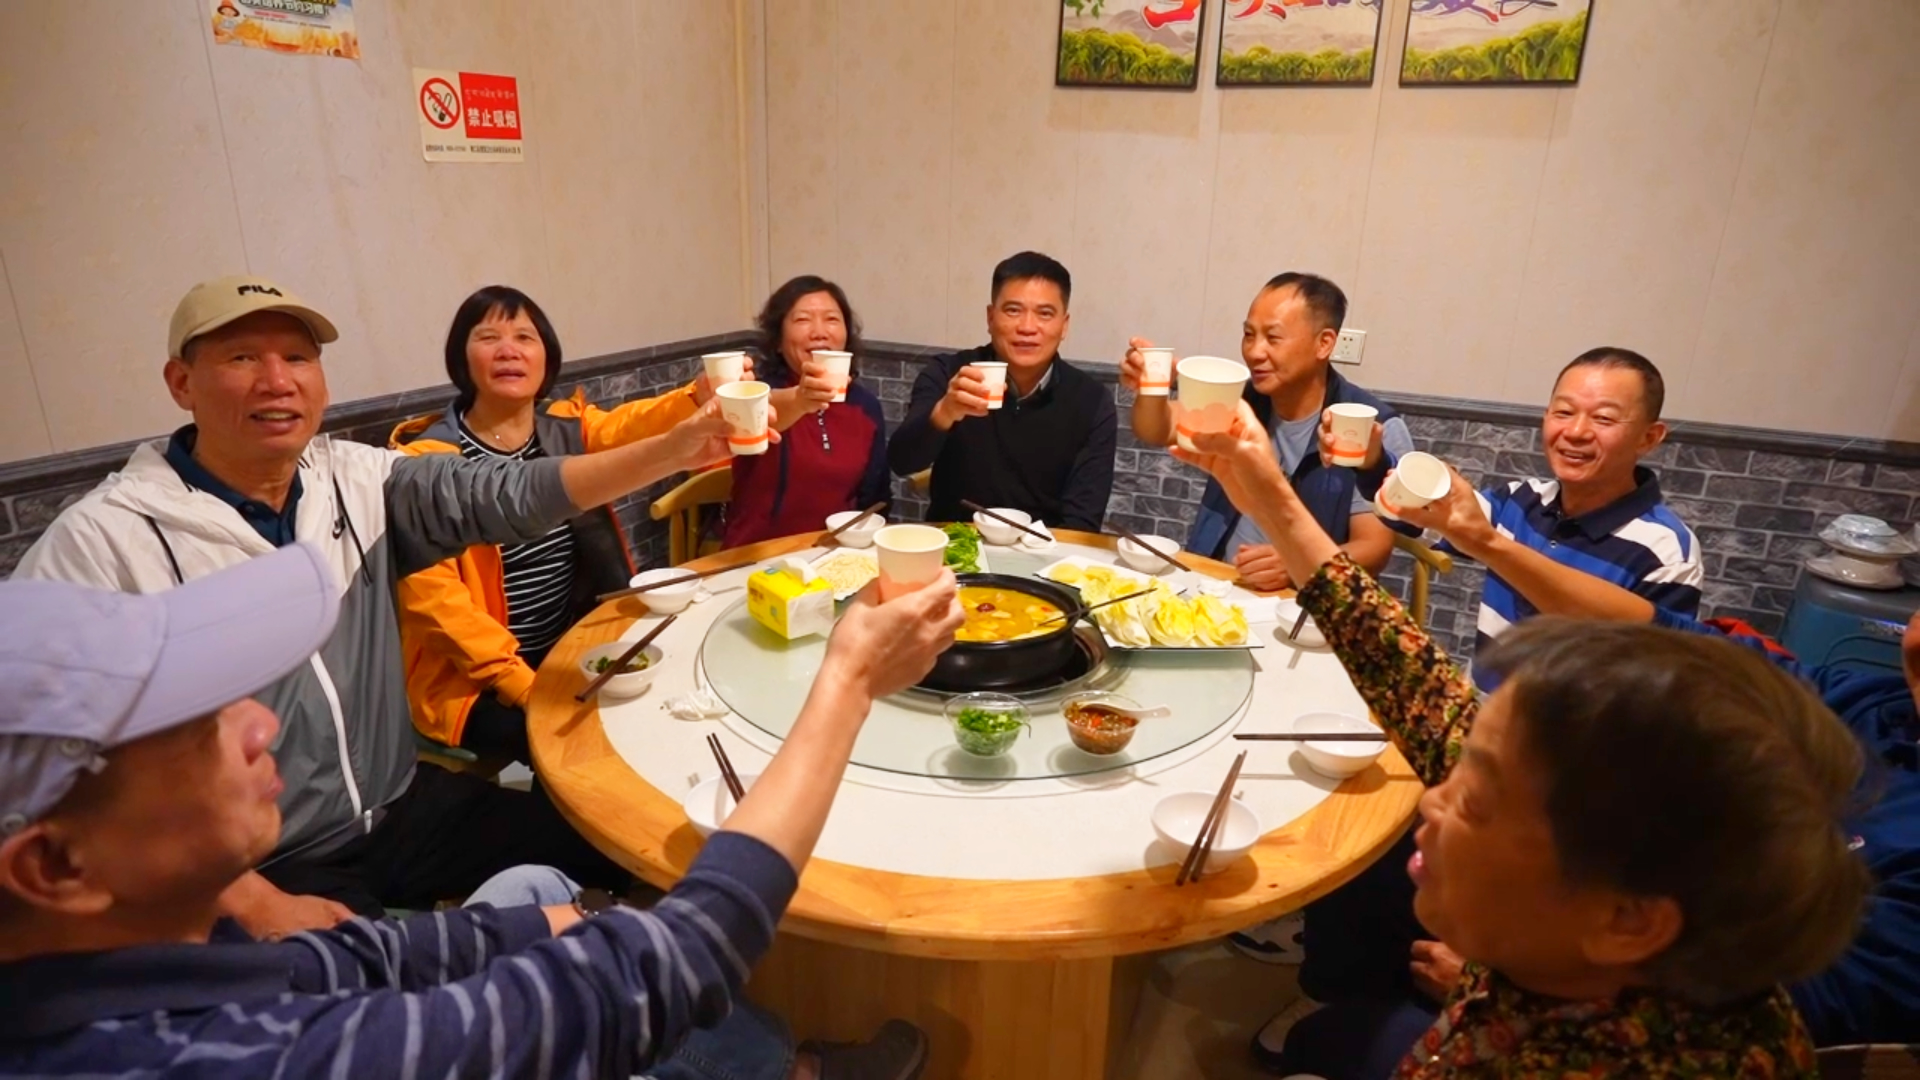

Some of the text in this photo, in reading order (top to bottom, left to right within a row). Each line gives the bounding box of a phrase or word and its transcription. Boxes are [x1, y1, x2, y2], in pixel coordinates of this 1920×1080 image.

[467, 107, 517, 129] 禁止吸烟
[237, 284, 283, 298] FILA
